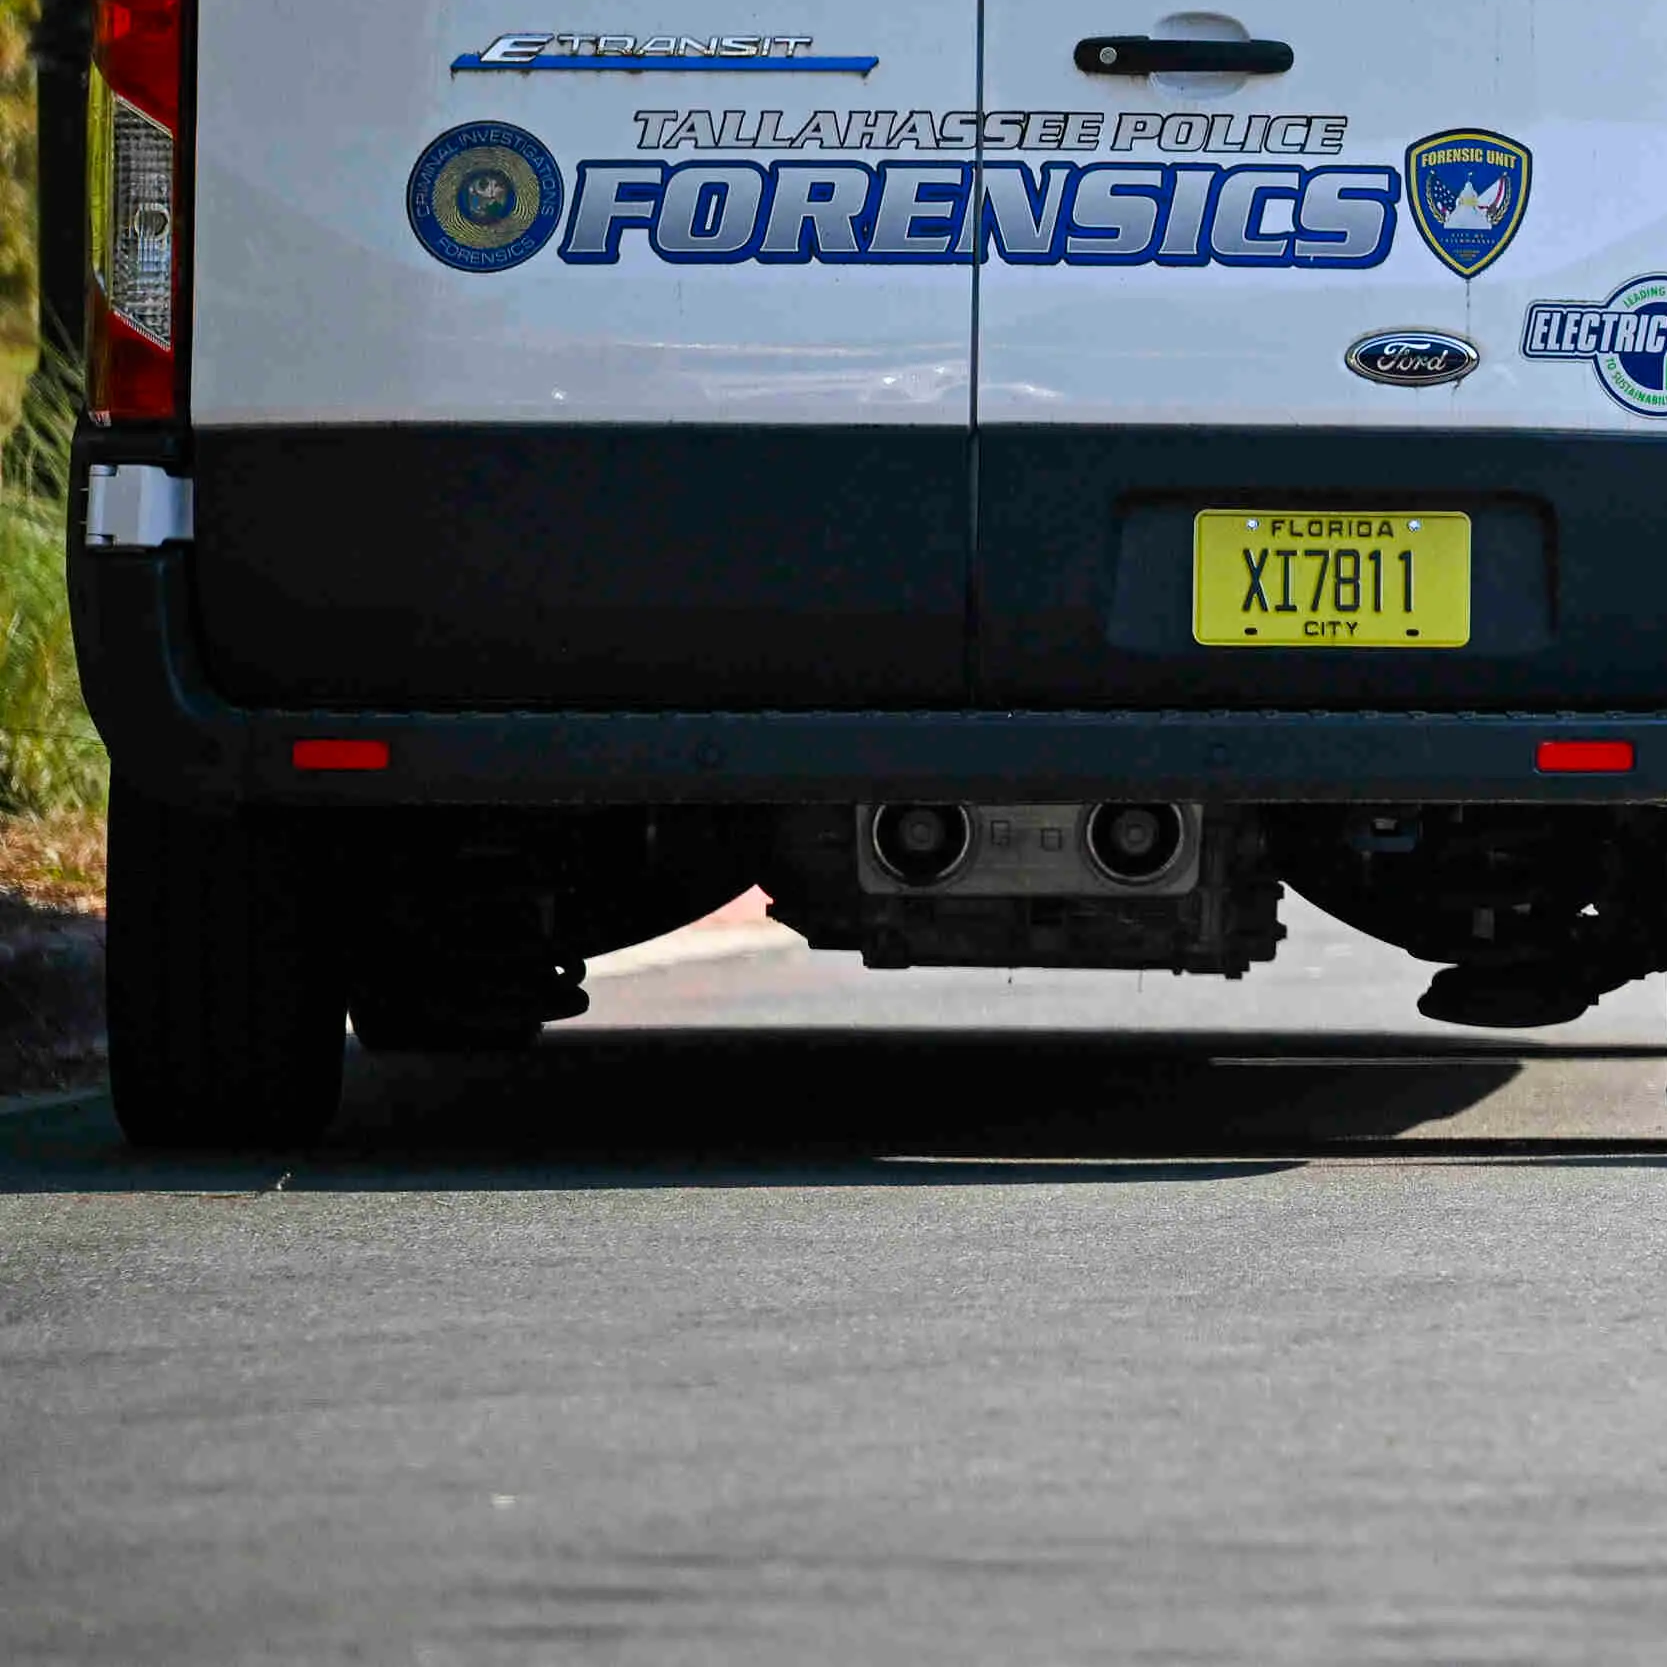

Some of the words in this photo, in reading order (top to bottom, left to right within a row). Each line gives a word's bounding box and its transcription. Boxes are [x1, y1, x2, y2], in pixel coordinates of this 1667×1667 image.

[634, 110, 1103, 151] TALLAHASSEE
[1110, 112, 1348, 155] POLICE
[415, 141, 459, 218] CRIMINAL
[457, 129, 557, 216] INVESTIGATIONS
[1421, 147, 1483, 168] FORENSIC
[1486, 149, 1517, 170] UNIT
[557, 160, 1400, 269] FORENSICS
[438, 235, 536, 265] FORENSICS
[1623, 285, 1667, 310] LEADING
[1377, 341, 1449, 371] Ford
[1605, 356, 1617, 370] TO
[1270, 519, 1395, 538] FLORIDA
[1242, 548, 1415, 614] XI7811
[1303, 620, 1360, 638] CITY
